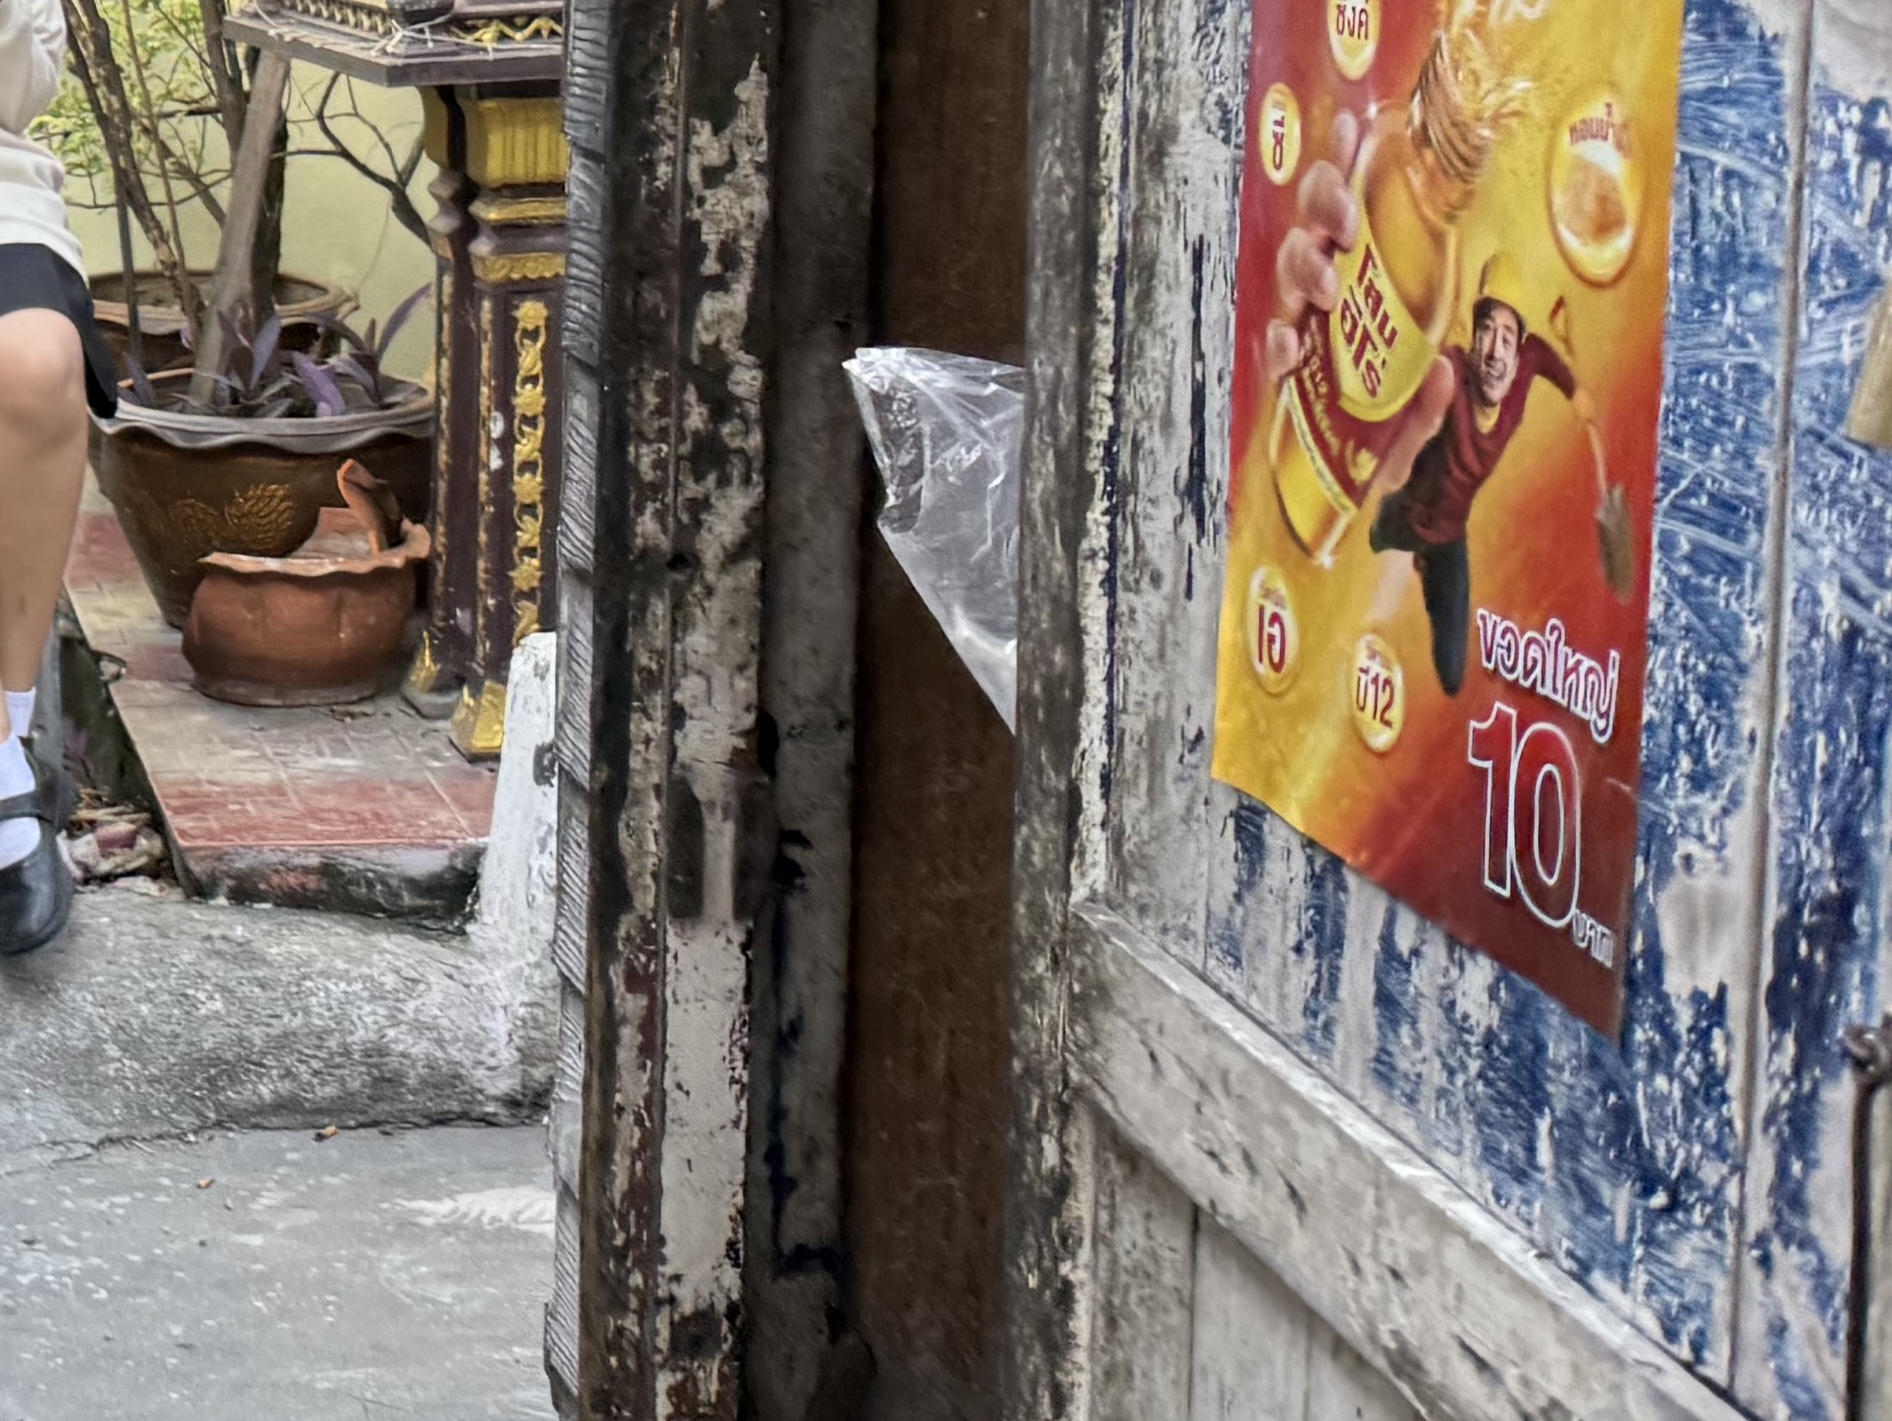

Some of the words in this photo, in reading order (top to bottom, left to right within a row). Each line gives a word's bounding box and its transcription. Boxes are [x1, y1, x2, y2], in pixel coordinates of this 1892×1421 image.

[1476, 607, 1620, 745] ขวดใหญ่
[1468, 700, 1581, 928] 10
